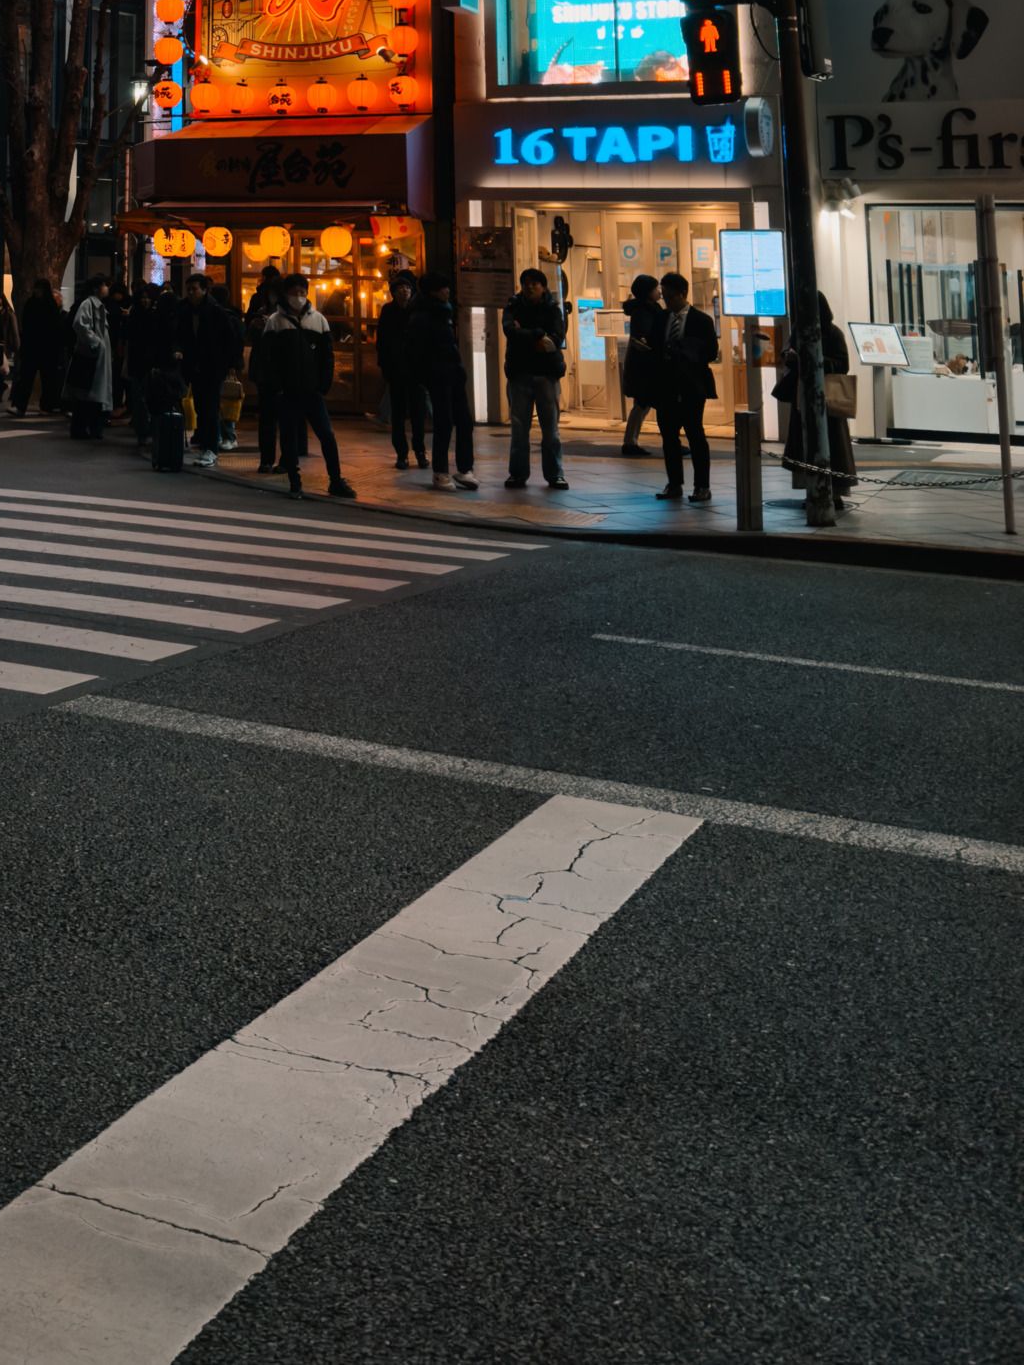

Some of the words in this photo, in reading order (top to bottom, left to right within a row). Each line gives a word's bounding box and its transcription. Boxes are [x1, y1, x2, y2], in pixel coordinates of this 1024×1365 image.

[249, 38, 354, 60] SHINJUKU
[494, 128, 555, 165] 16
[562, 126, 693, 164] TAPI
[827, 107, 1024, 172] P's-fir
